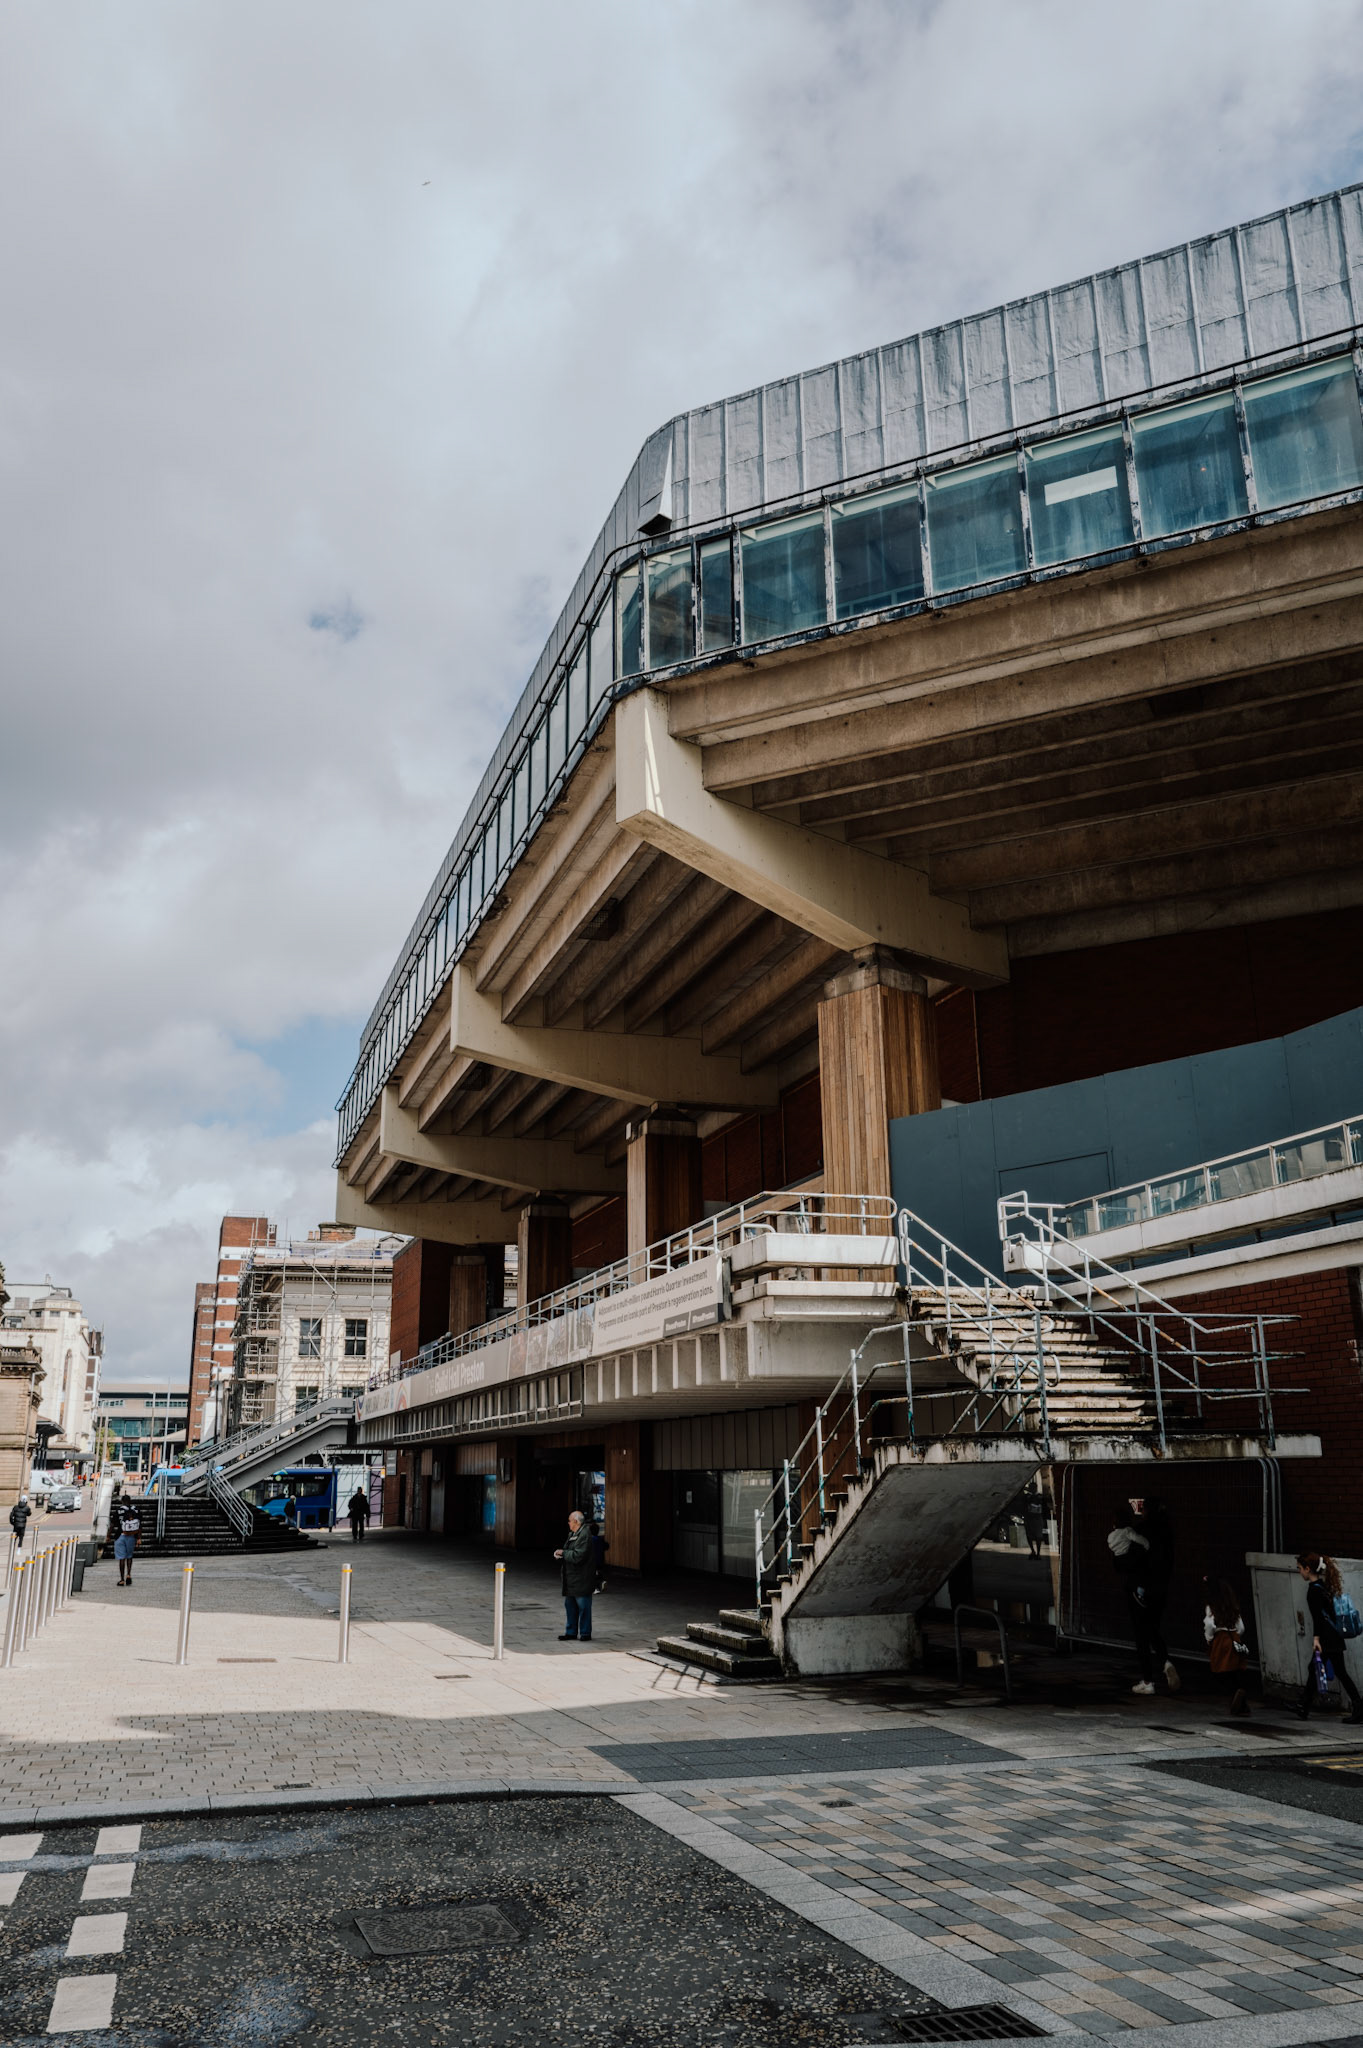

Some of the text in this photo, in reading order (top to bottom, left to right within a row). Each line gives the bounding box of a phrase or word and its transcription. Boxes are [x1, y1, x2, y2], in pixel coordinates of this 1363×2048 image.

[639, 1307, 648, 1318] part
[672, 1290, 699, 1307] regeneration
[700, 1286, 714, 1298] plans.
[641, 1289, 653, 1303] pound
[653, 1286, 665, 1297] Harris
[666, 1280, 682, 1292] Quarter
[682, 1269, 707, 1286] Investment
[461, 1360, 484, 1386] Preston
